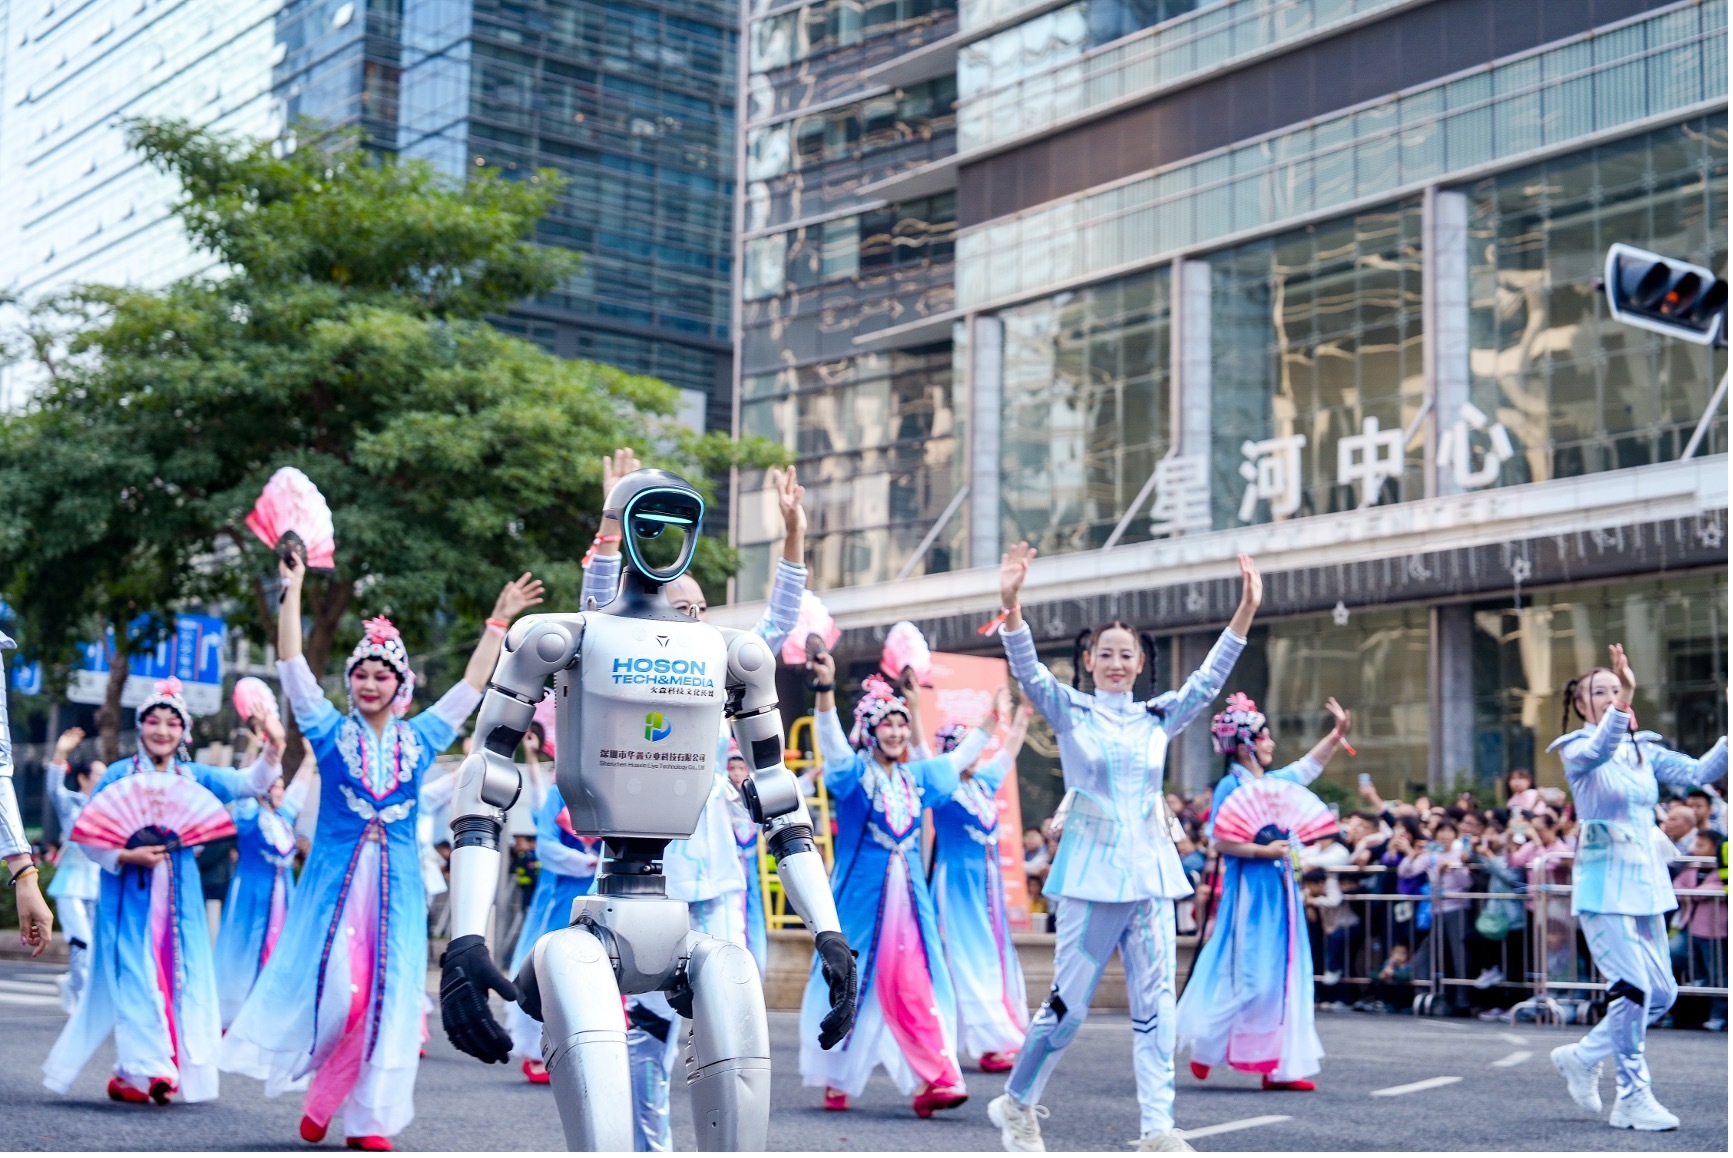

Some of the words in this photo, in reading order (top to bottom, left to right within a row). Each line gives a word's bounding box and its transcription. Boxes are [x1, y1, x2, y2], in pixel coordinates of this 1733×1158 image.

[1149, 401, 1514, 537] 星河中心
[612, 658, 705, 675] HOSON
[612, 675, 713, 687] TECH&MEDIA
[660, 763, 688, 771] Technology
